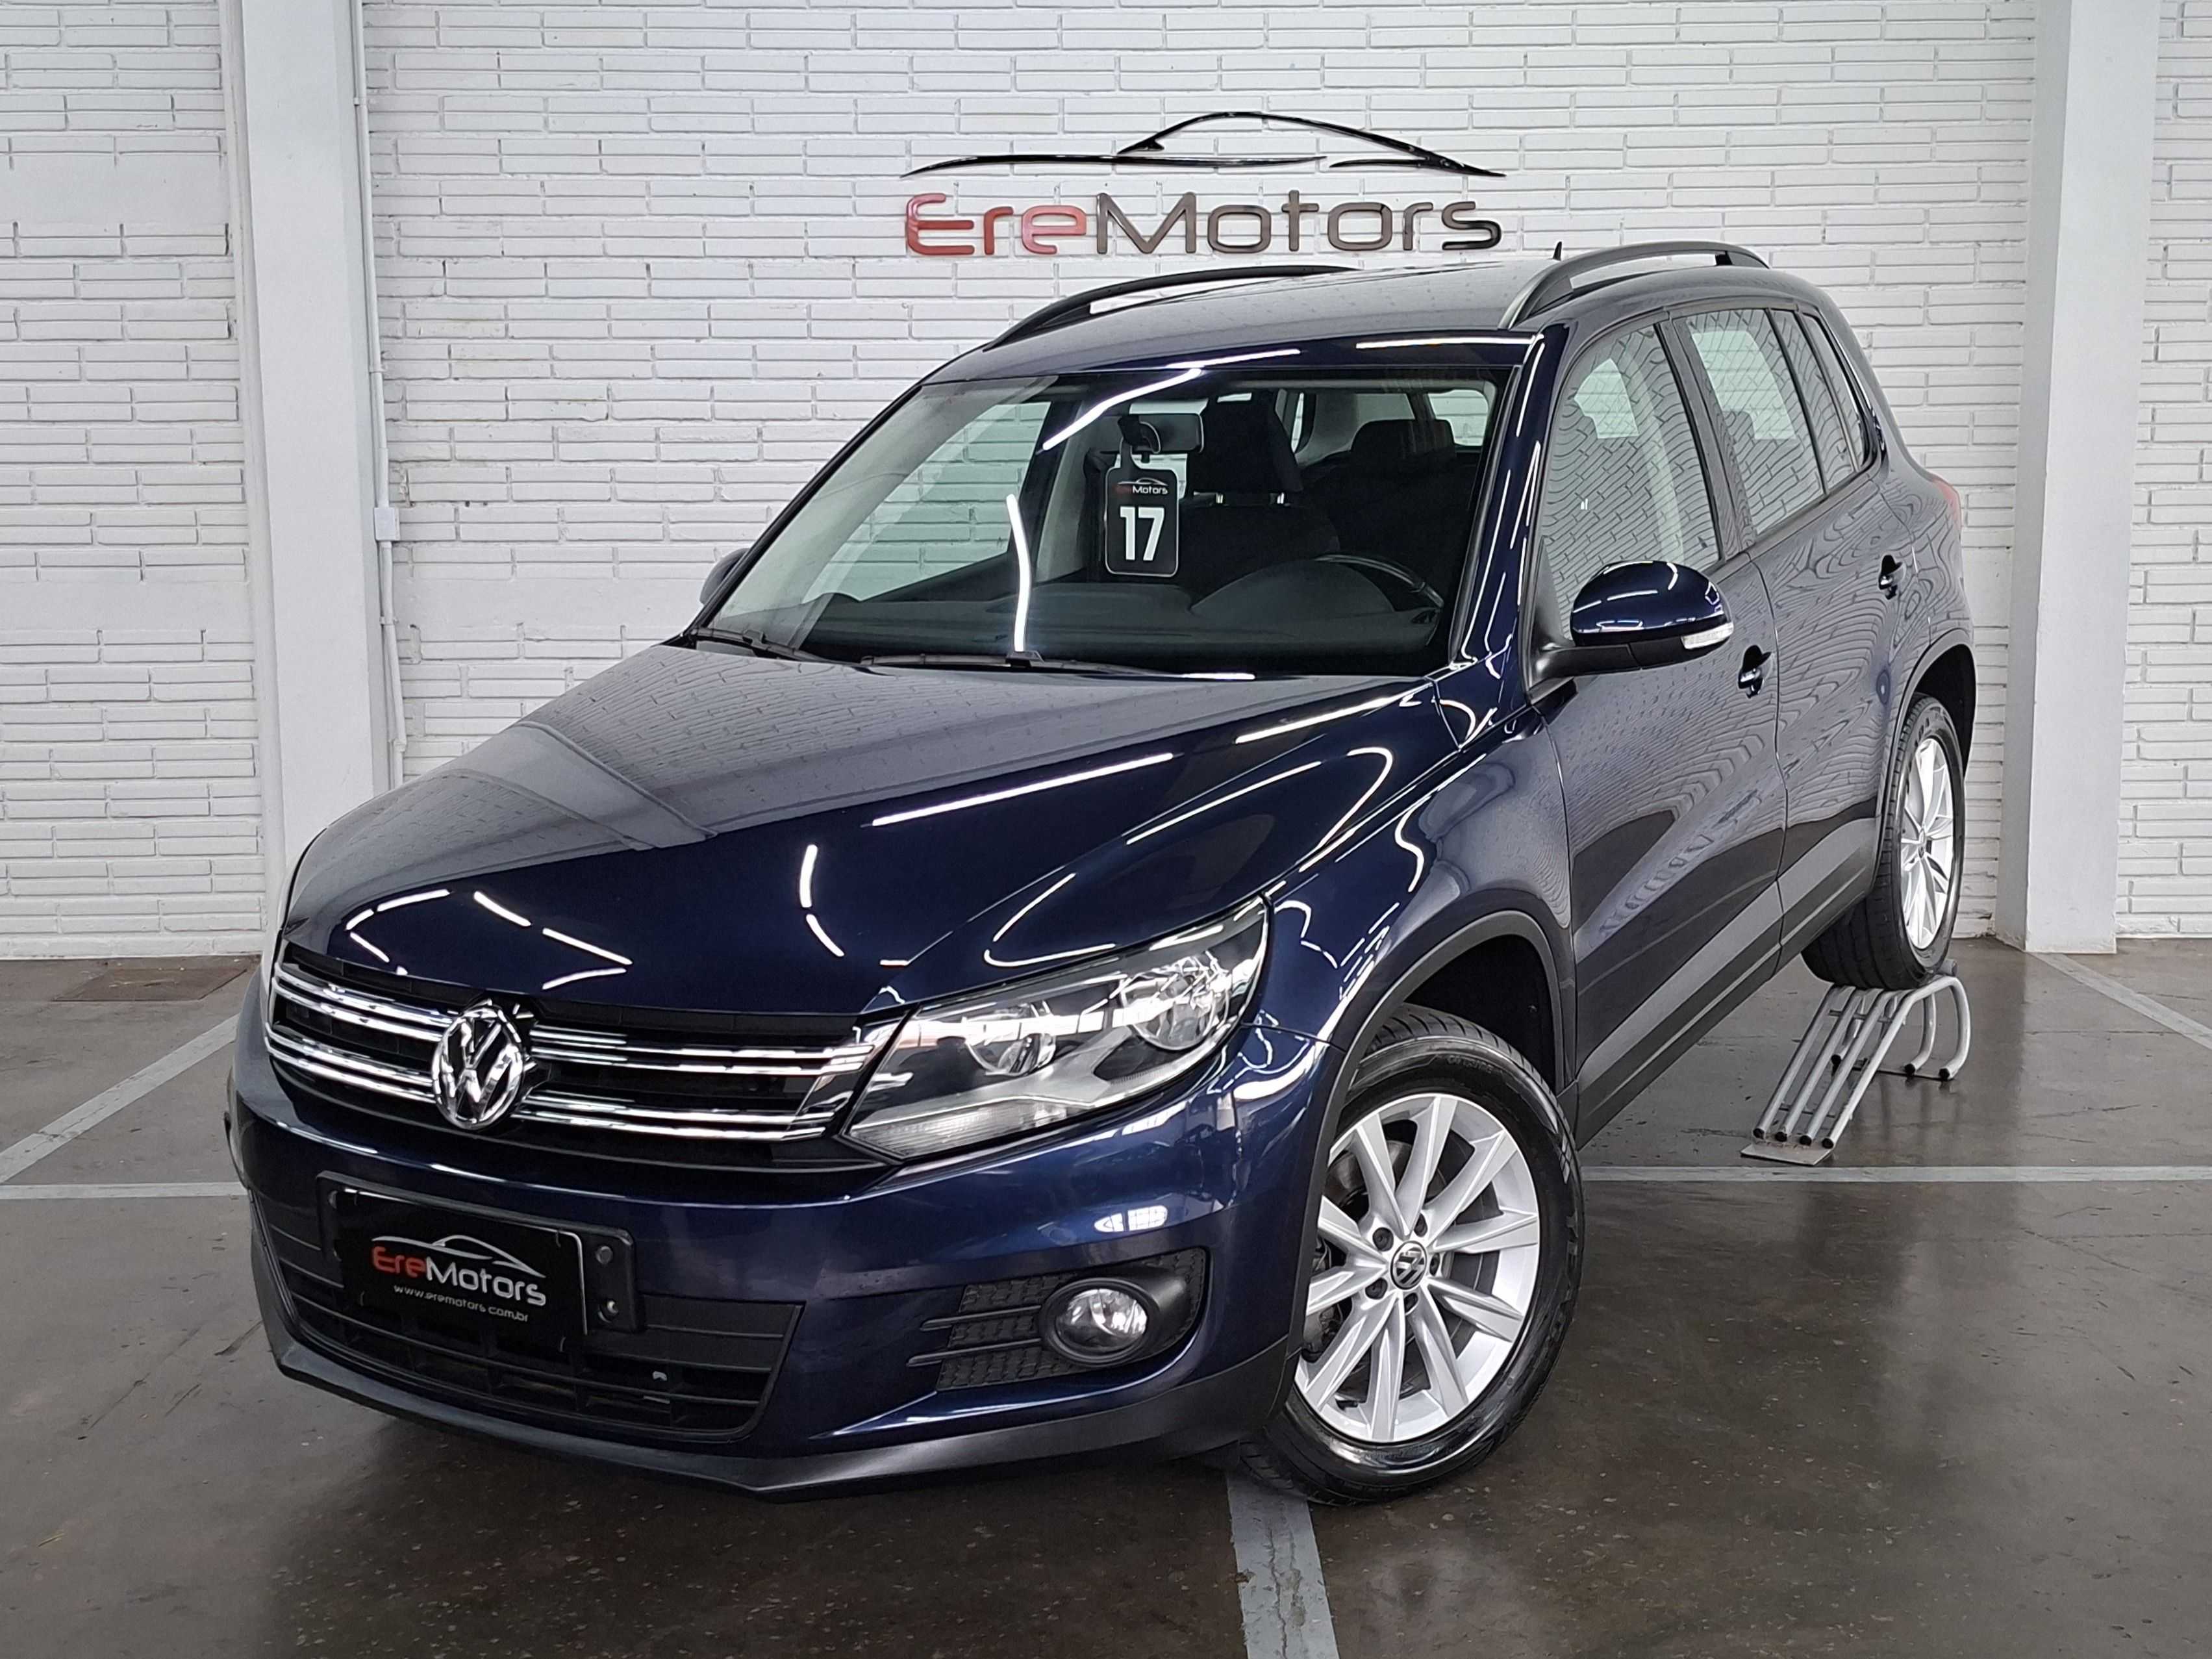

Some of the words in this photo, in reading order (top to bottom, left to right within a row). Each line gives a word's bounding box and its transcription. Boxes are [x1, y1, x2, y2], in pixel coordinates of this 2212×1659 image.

[905, 190, 1502, 255] EreMotors
[1120, 506, 1164, 561] 17
[371, 1246, 546, 1306] EreMotors
[394, 1284, 529, 1323] www.eremotorscom.br
